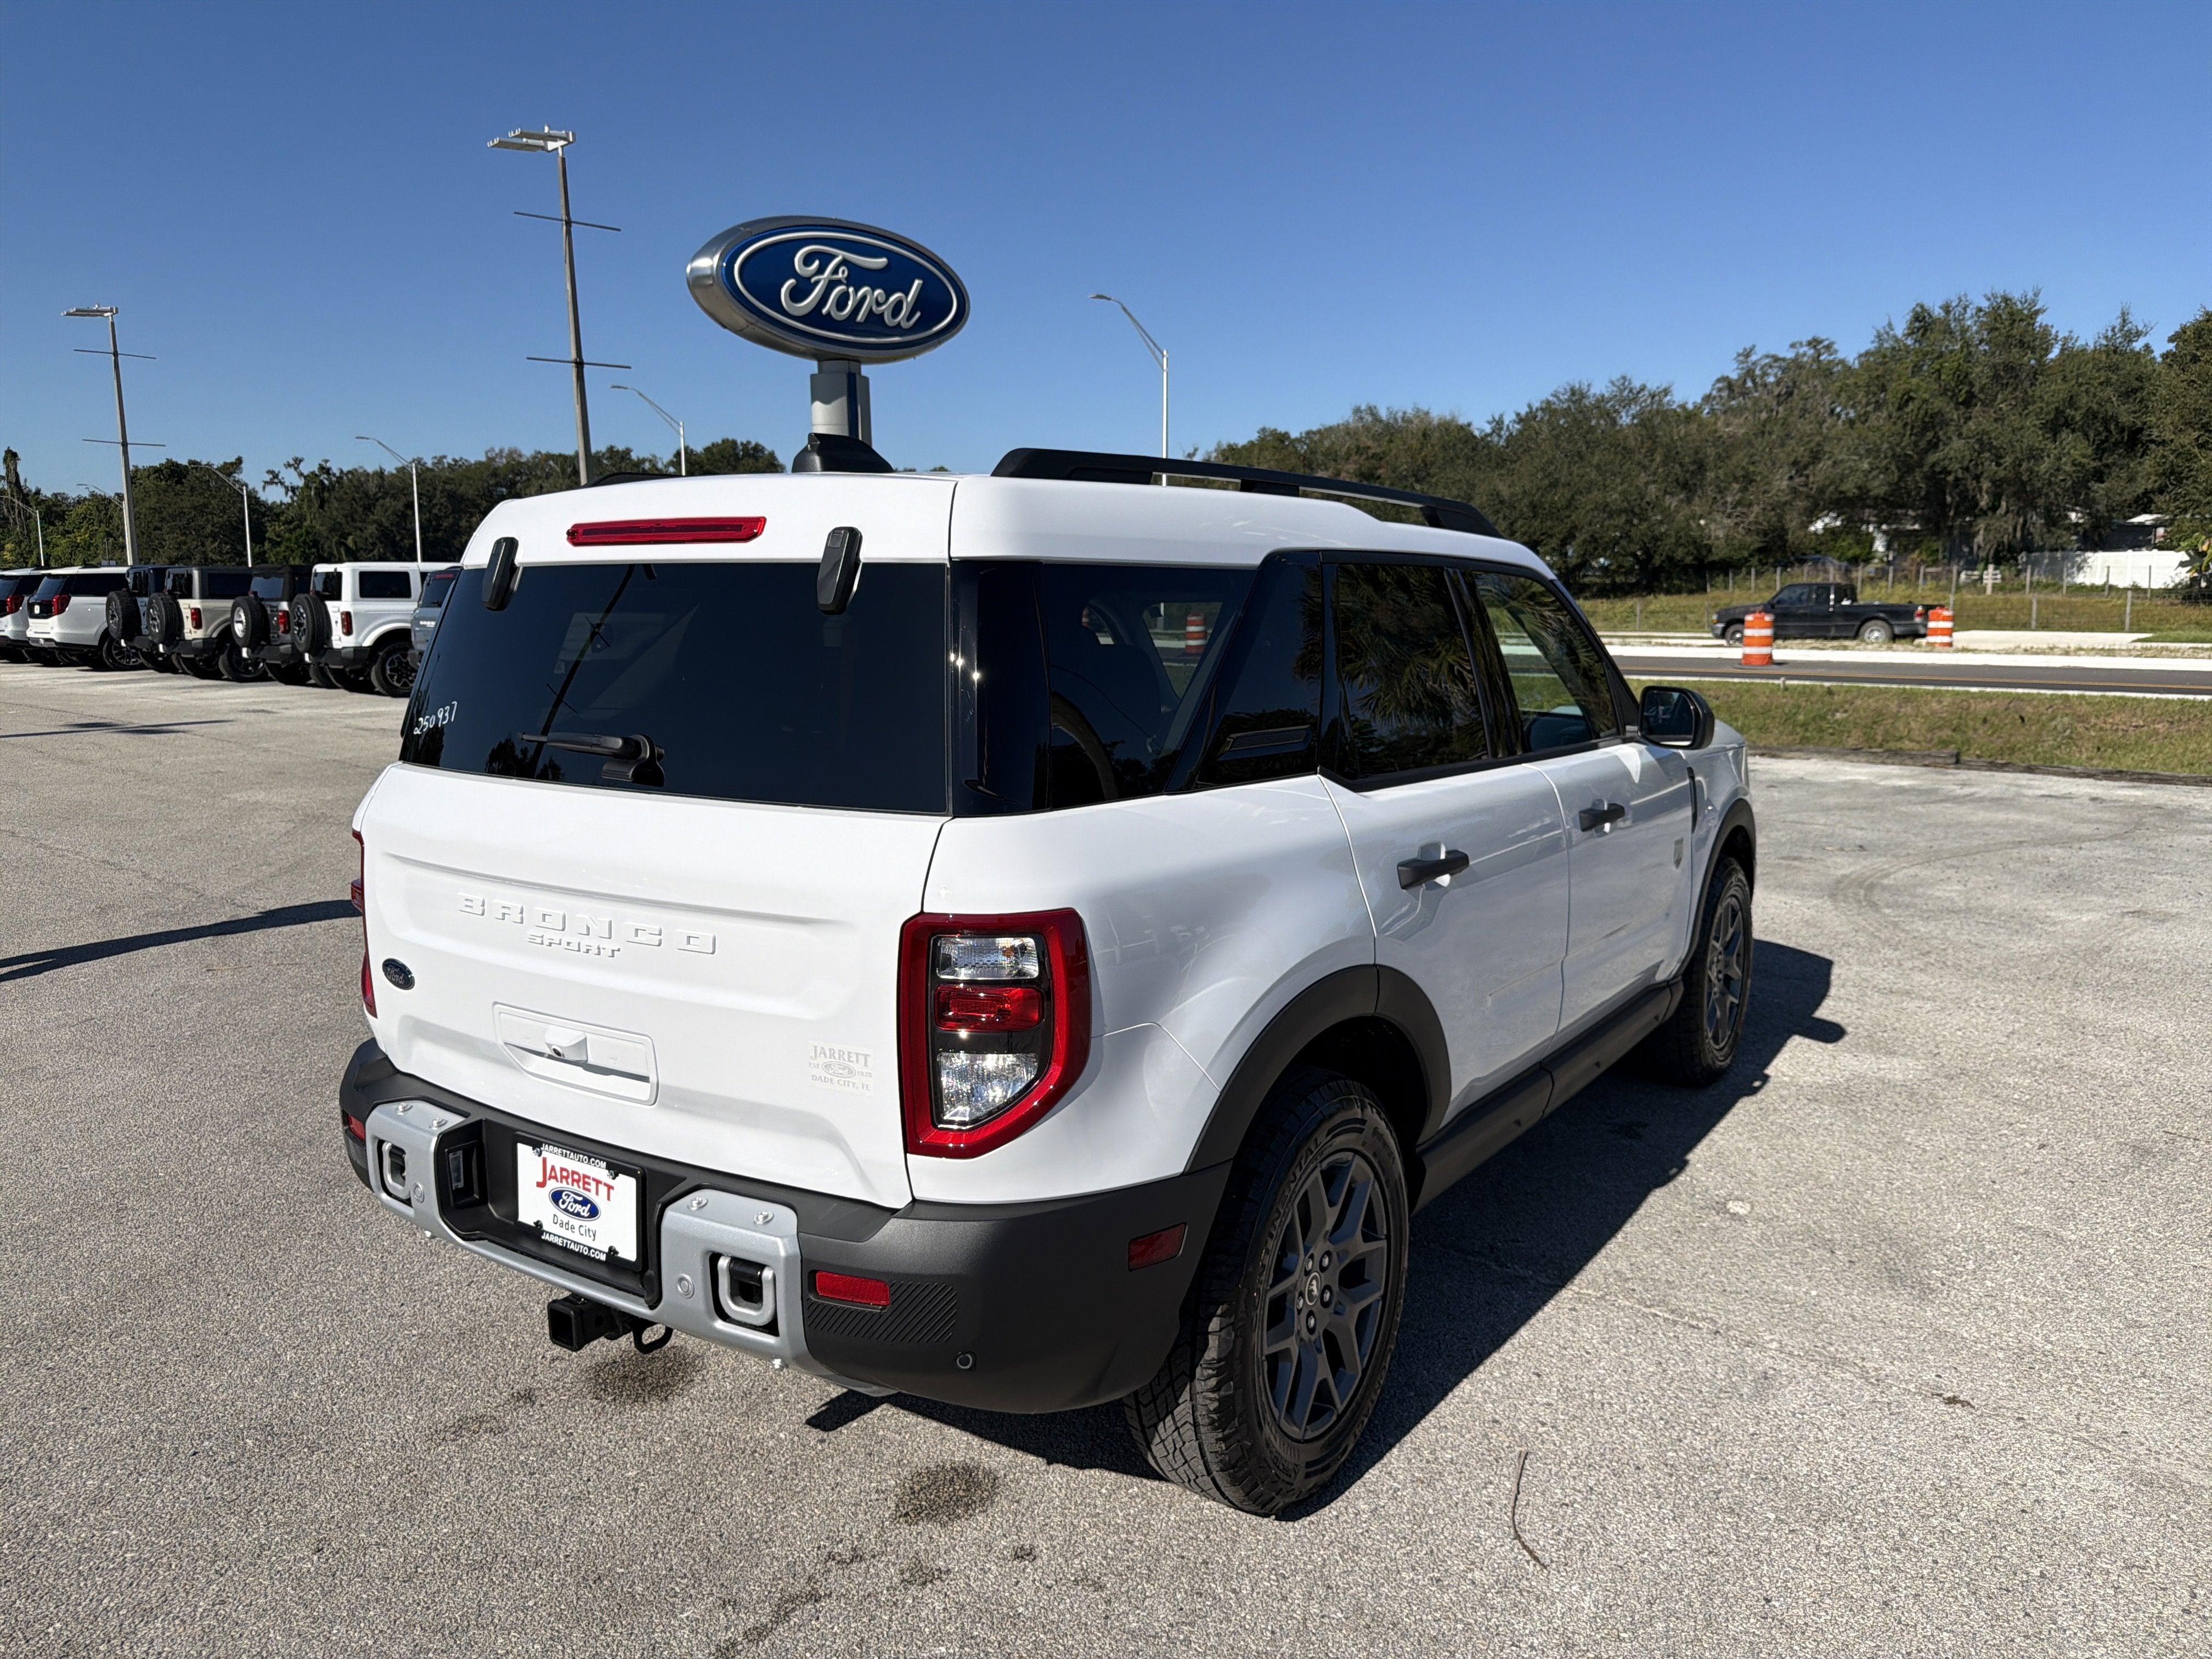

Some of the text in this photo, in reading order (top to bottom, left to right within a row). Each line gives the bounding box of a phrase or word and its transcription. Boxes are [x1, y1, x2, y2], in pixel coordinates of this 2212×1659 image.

[781, 244, 923, 329] Ford
[456, 891, 717, 956] BRONCO
[527, 931, 621, 959] SPORT
[386, 964, 405, 985] Ford
[809, 1045, 871, 1068] JARRETT
[811, 1074, 835, 1085] DADE
[862, 1082, 871, 1091] FL
[540, 1143, 607, 1170] JARRETTAUTO.COM
[535, 1156, 614, 1201] JARRETT
[558, 1191, 590, 1218] Ford
[552, 1214, 597, 1242] Dade City
[541, 1232, 607, 1262] JARRETTAUTO.COM
